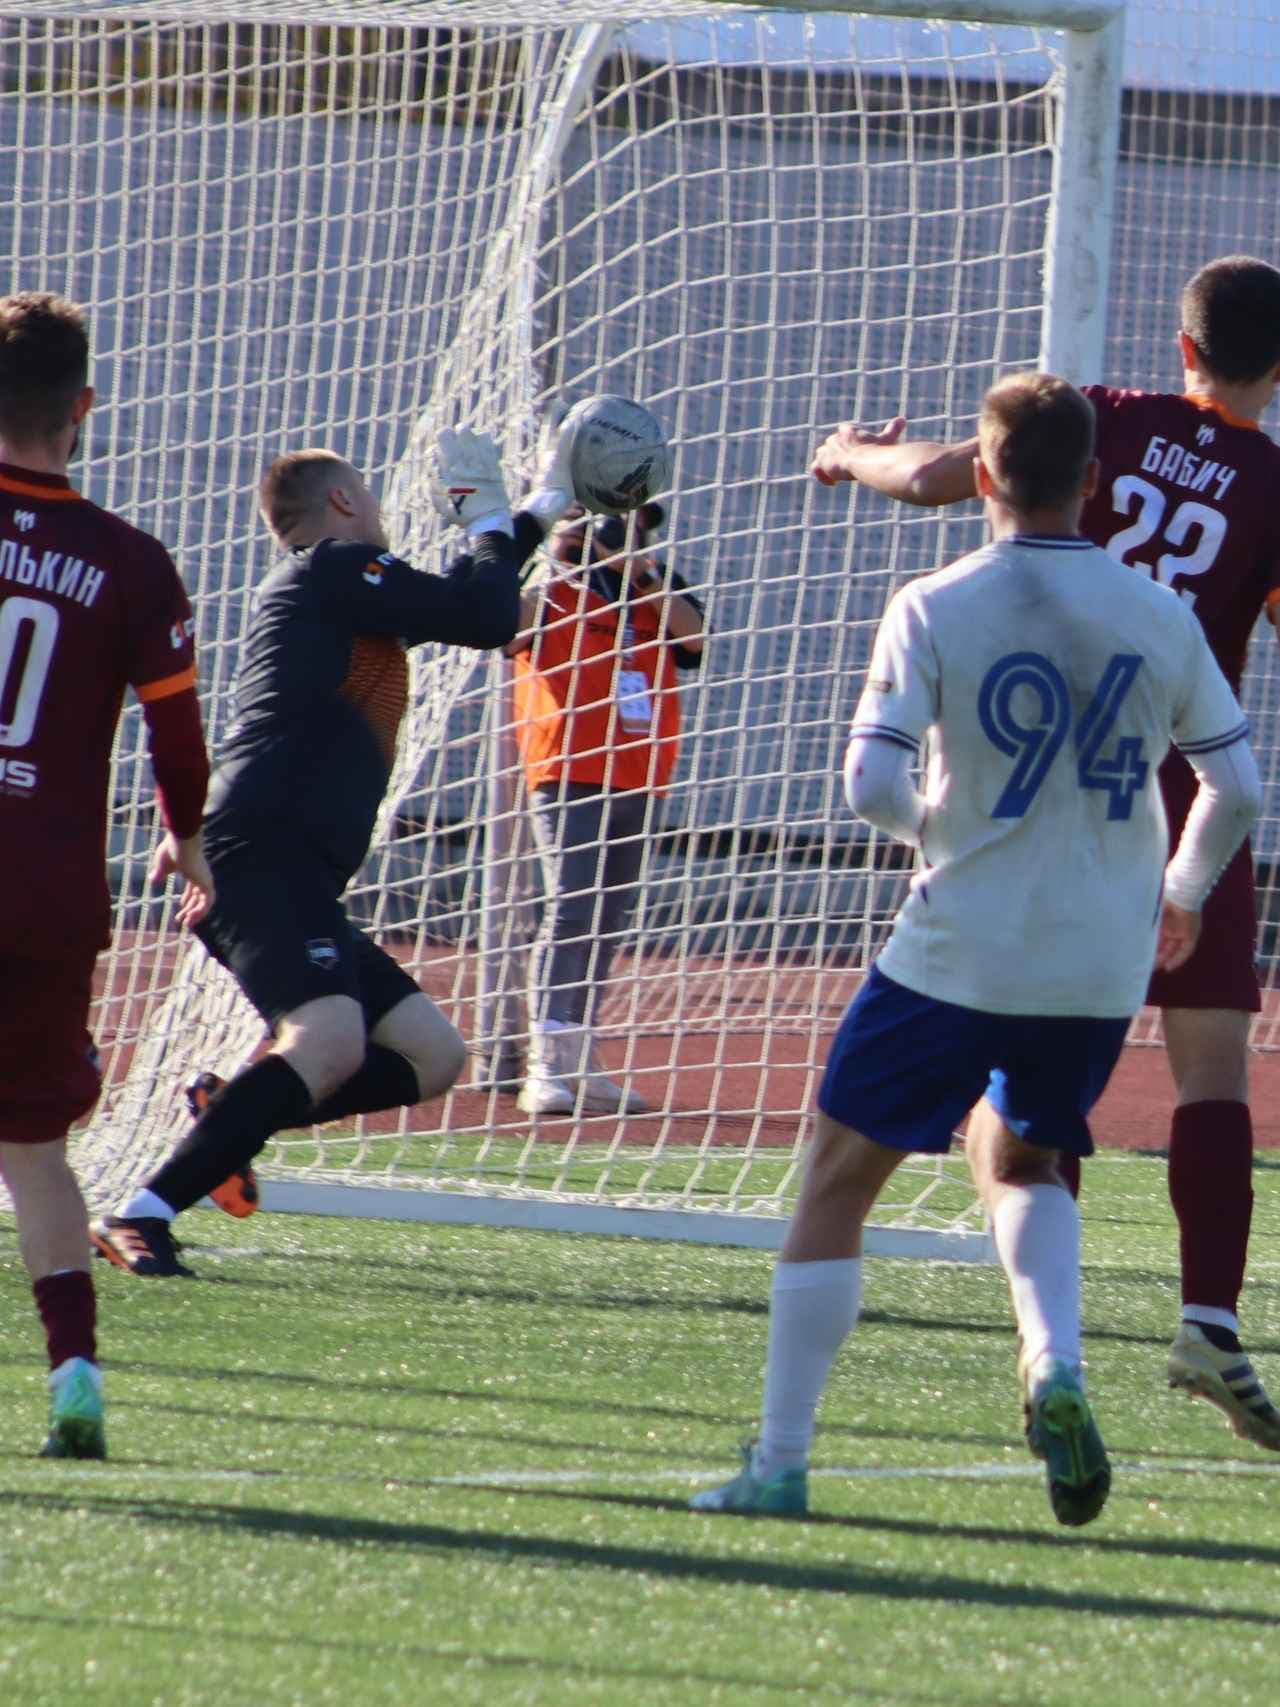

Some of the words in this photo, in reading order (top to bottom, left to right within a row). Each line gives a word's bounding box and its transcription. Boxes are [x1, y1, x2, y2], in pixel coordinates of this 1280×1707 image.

[1140, 435, 1237, 501] БАБИЧ
[1105, 474, 1229, 606] 22
[977, 650, 1149, 821] 94
